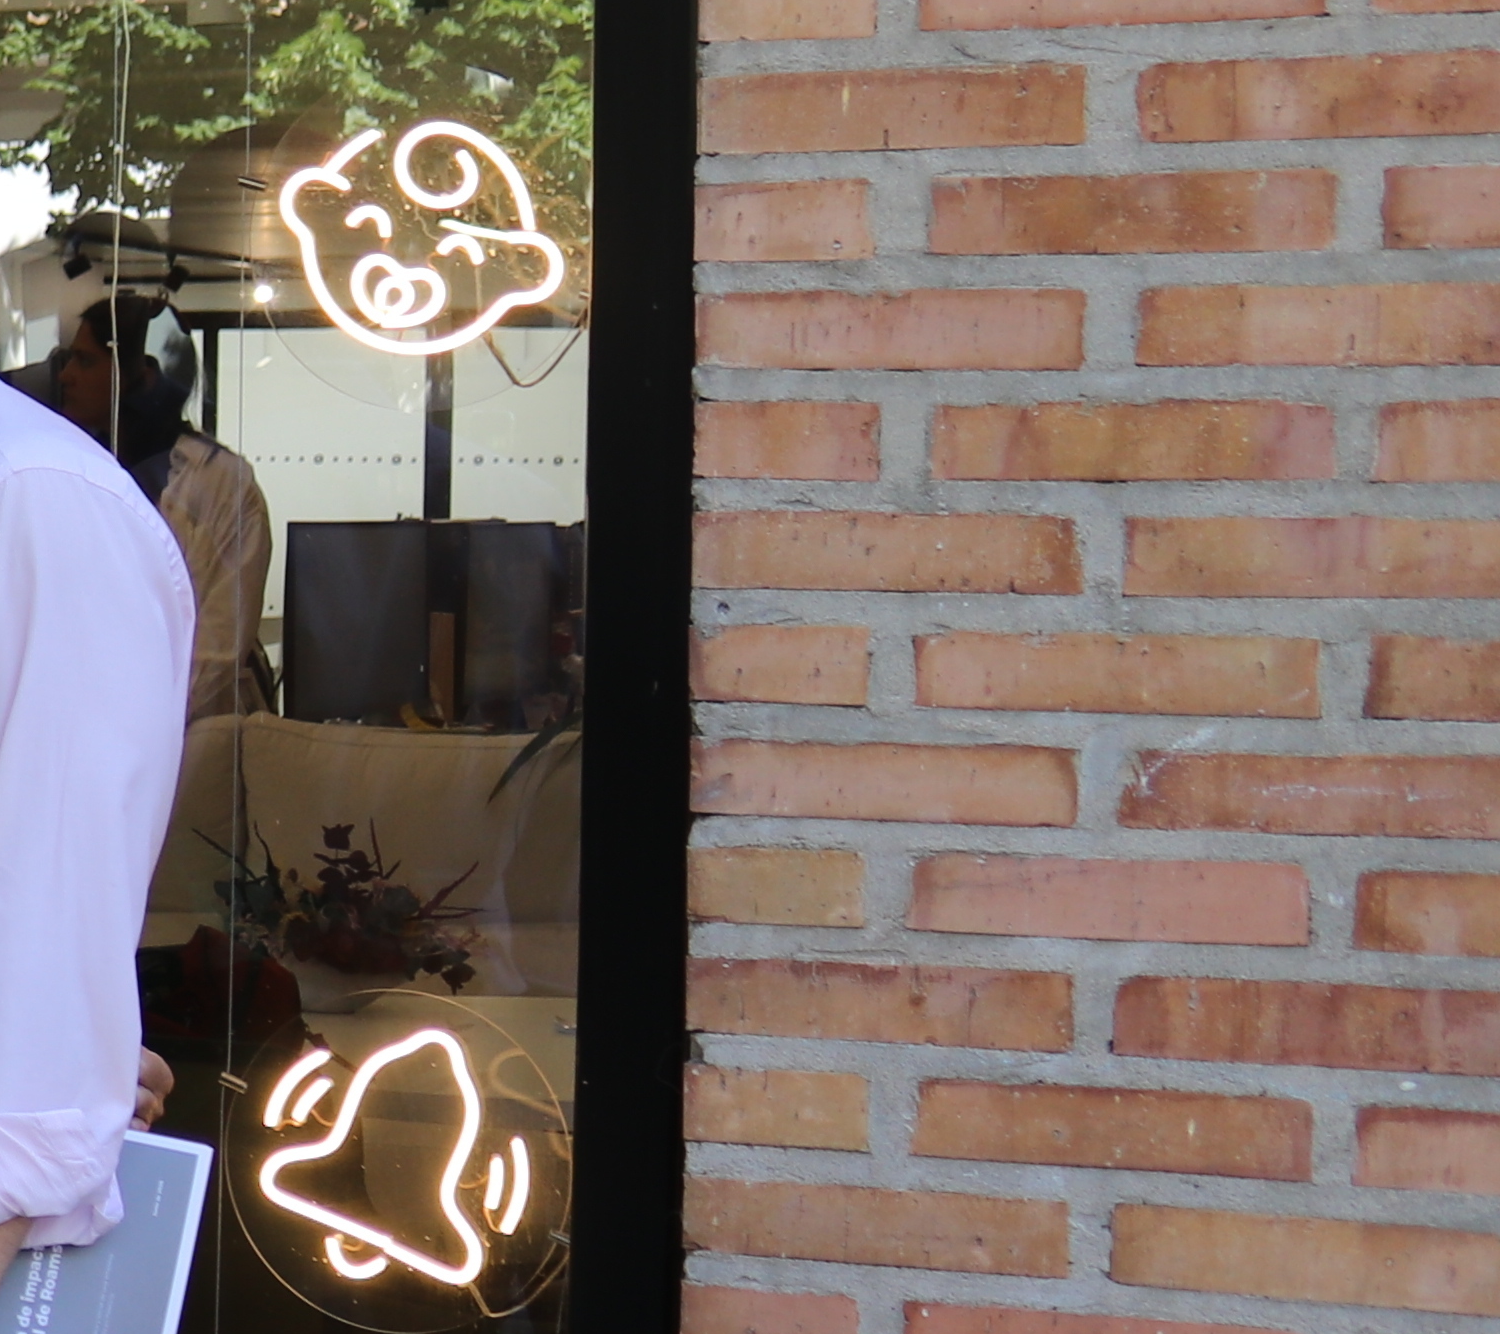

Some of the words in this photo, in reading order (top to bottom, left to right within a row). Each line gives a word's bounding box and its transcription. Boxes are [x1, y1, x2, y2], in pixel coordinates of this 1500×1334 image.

[40, 1245, 63, 1301] Roams
[16, 1305, 32, 1327] de
[36, 1304, 51, 1326] de
